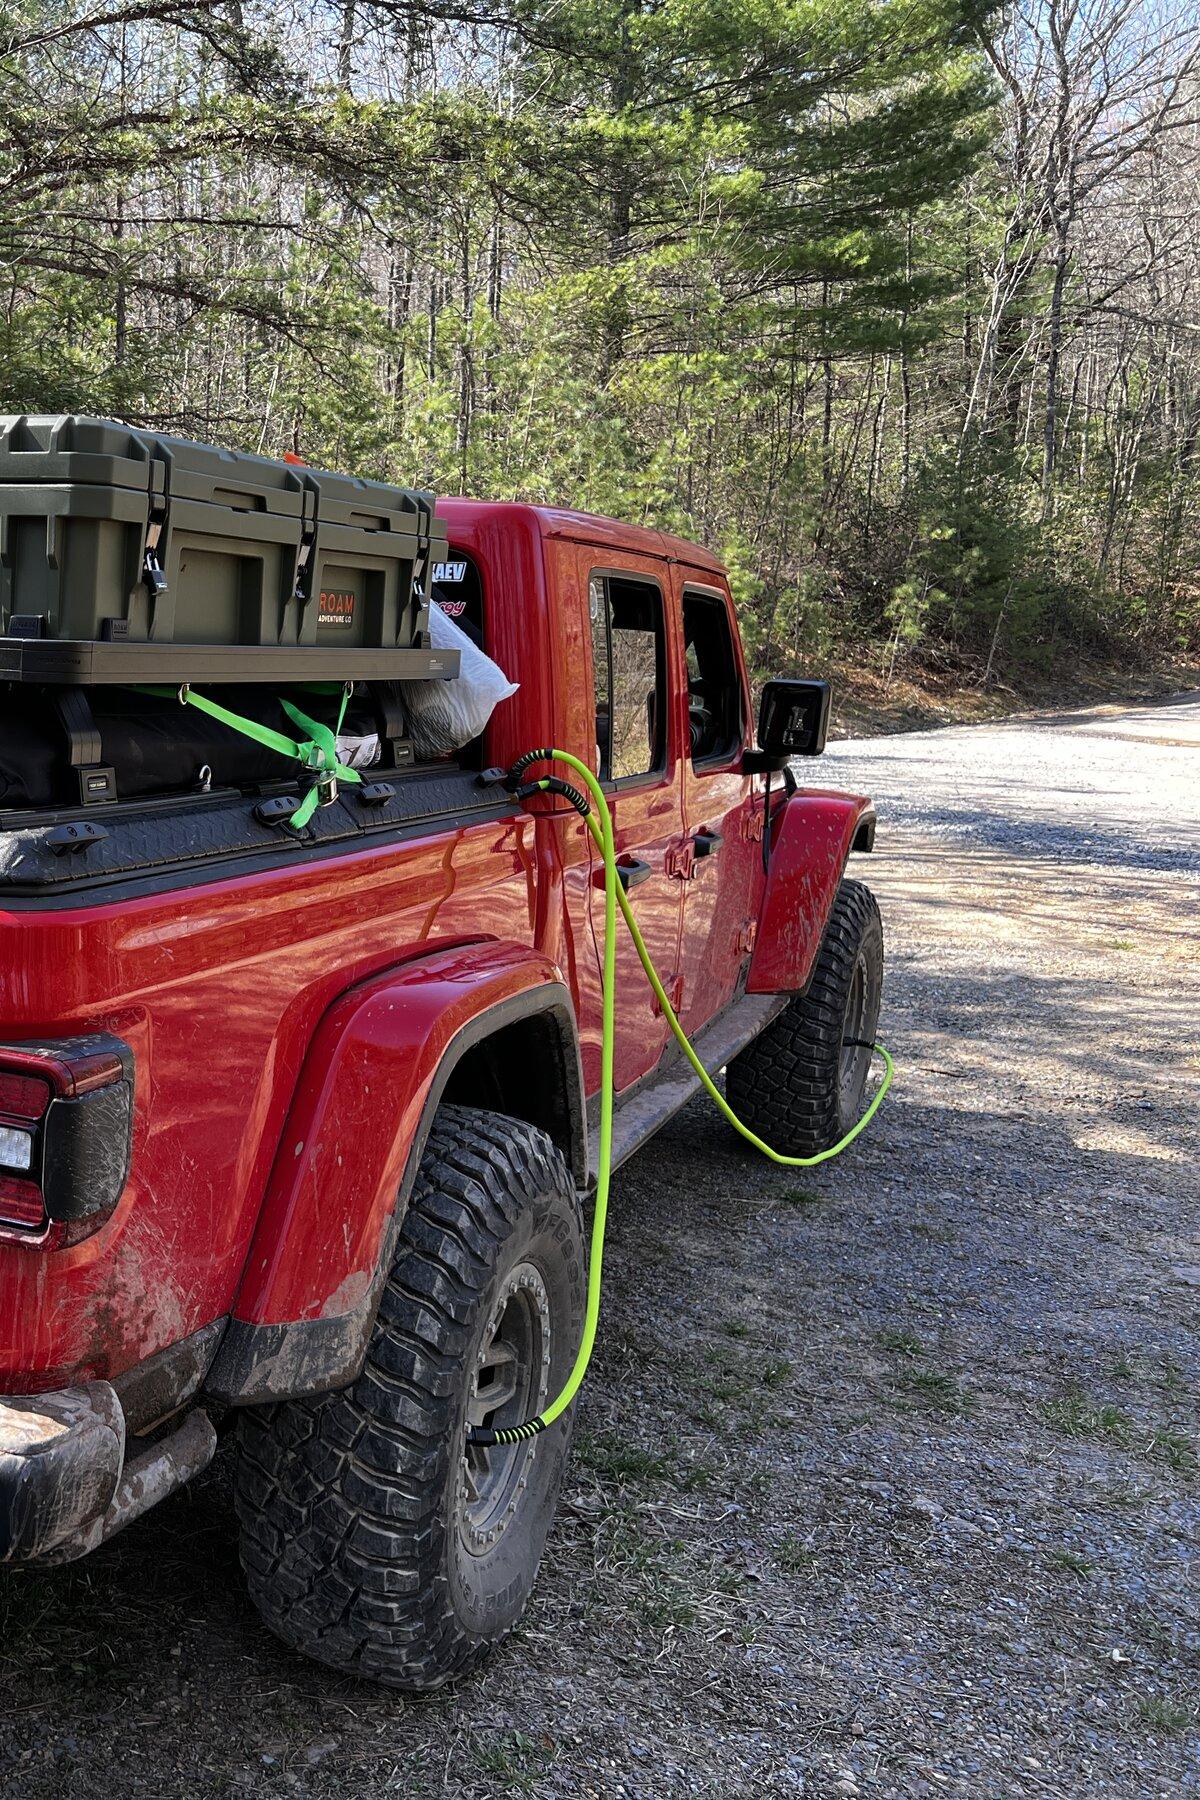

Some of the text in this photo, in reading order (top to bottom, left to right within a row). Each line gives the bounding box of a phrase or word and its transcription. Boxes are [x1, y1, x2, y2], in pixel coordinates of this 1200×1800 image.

[435, 563, 464, 580] AEV
[319, 592, 354, 613] ROAM
[318, 615, 345, 623] ADVENTURE
